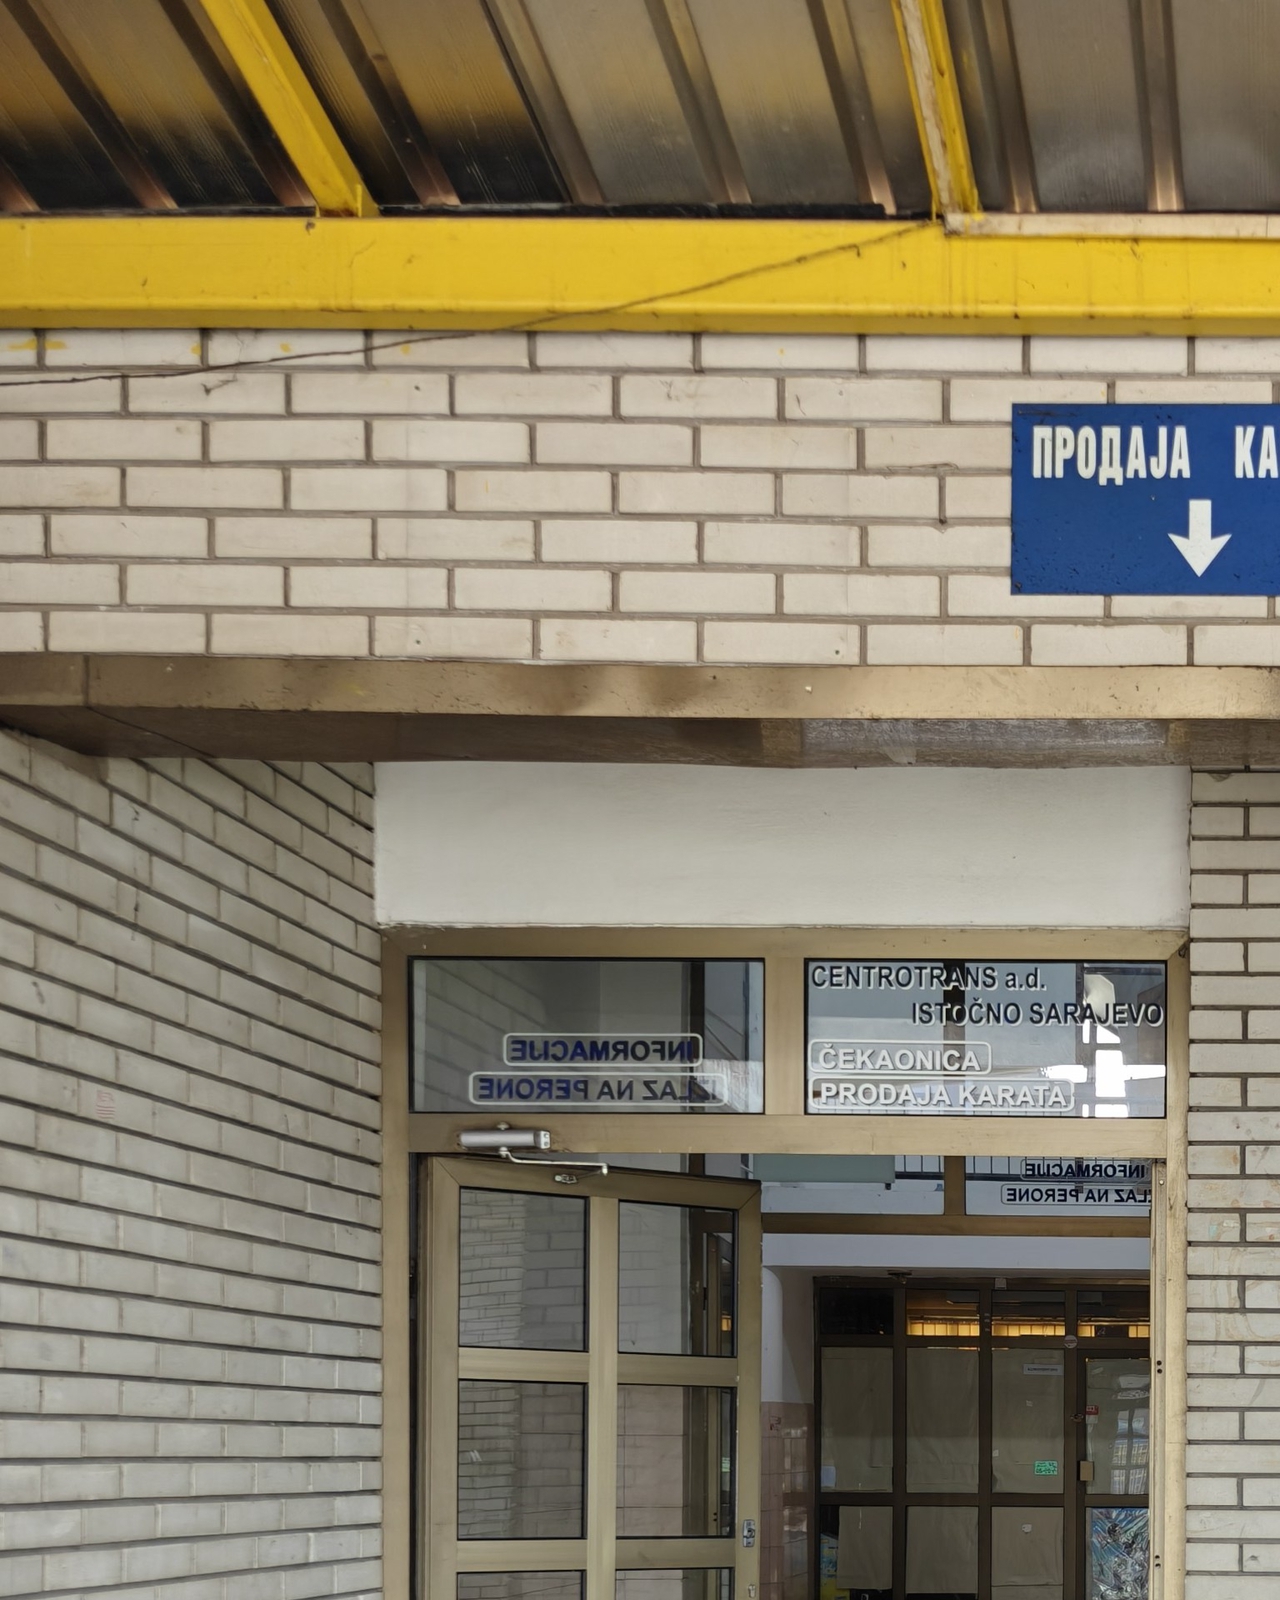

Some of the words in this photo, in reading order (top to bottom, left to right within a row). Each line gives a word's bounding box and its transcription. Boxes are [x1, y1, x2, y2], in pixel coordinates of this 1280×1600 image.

[1032, 425, 1191, 486] ПРОДАЈА
[811, 965, 998, 990] CENTROTRANS
[1005, 967, 1047, 991] a.d.
[911, 997, 1023, 1026] ISTOČNO
[1029, 1002, 1165, 1027] SARAJEVO
[817, 1043, 982, 1072] ČEKAONICA
[820, 1082, 952, 1107] PRODAJA
[958, 1084, 1069, 1108] KARATA
